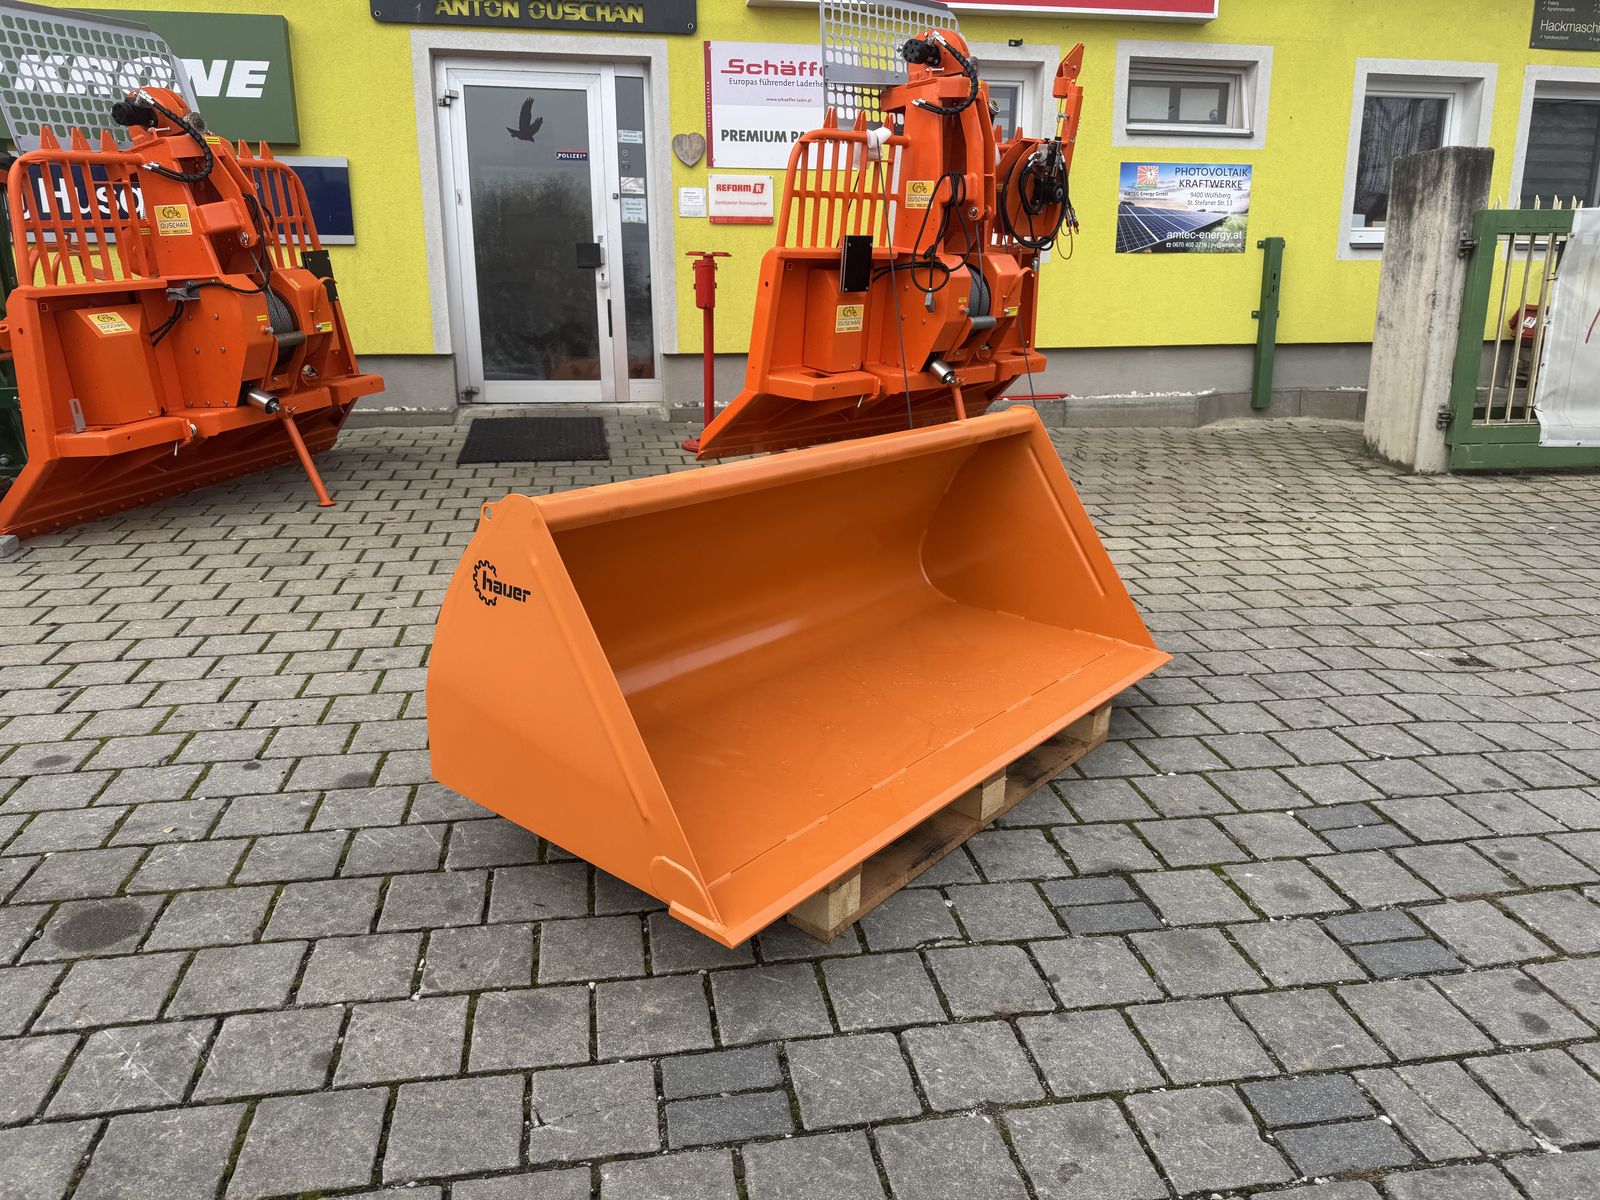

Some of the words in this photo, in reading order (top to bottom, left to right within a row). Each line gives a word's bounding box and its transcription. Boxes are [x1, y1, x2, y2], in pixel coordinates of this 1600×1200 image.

[434, 0, 519, 18] ANTON
[528, 0, 644, 23] OUSCHAN
[720, 58, 823, 77] Schäff
[728, 77, 758, 87] Europas
[759, 78, 795, 88] führender
[721, 129, 787, 143] PREMIUM
[1174, 166, 1248, 177] PHOTOVOLTAIK
[716, 183, 752, 192] REFORM
[1179, 179, 1243, 189] KRAFTWERKE
[1190, 191, 1204, 199] 9400
[1204, 191, 1231, 200] Wolfsberg
[1166, 230, 1242, 241] amtec-energy.at
[482, 570, 531, 602] hauer
